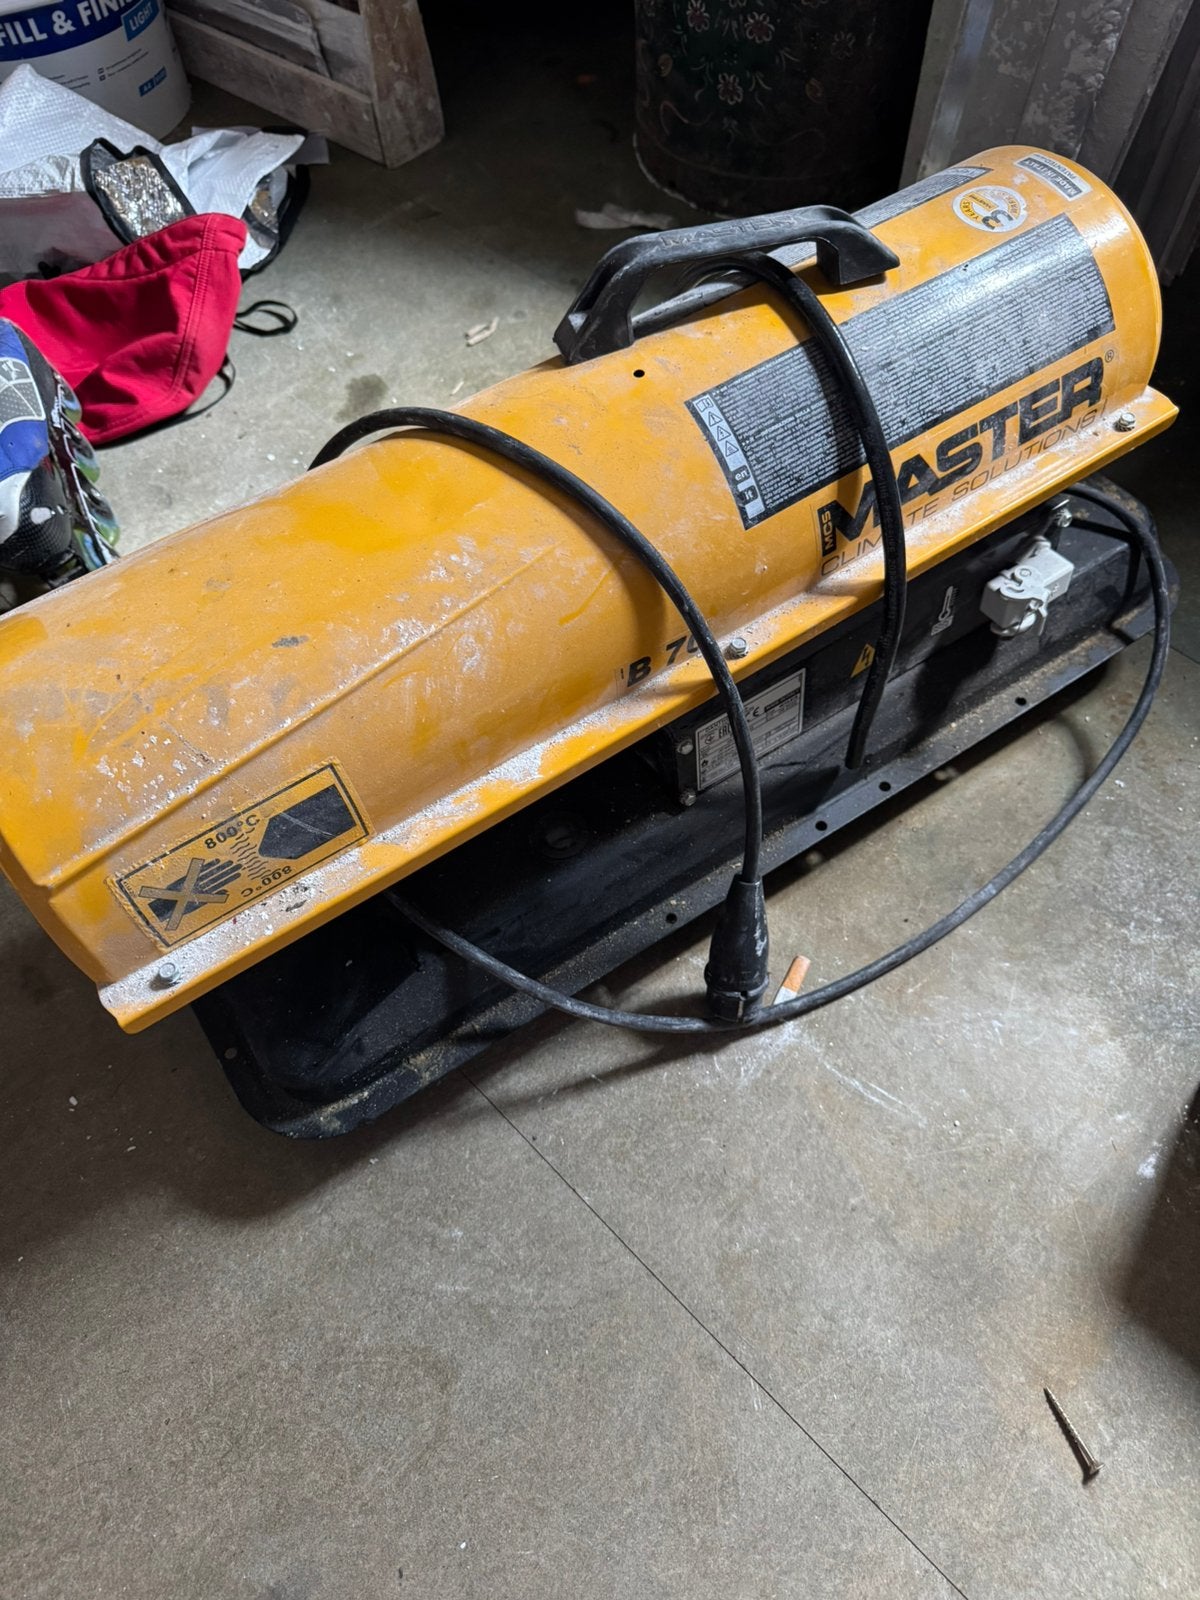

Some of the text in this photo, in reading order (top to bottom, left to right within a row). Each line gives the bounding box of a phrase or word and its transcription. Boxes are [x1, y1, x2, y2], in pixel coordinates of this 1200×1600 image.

[52, 10, 76, 35] &
[77, 0, 134, 27] FIN
[129, 1, 153, 31] LIGHT
[1025, 160, 1047, 173] ITALY
[1056, 176, 1077, 195] MADE
[817, 356, 1104, 541] MASTER
[735, 469, 748, 481] en
[744, 491, 753, 500] it
[821, 497, 940, 576] CLIMTE
[952, 409, 1098, 501] SOLUTIONS
[822, 510, 833, 550] MCS
[627, 656, 652, 687] B
[204, 813, 260, 849] 800°C
